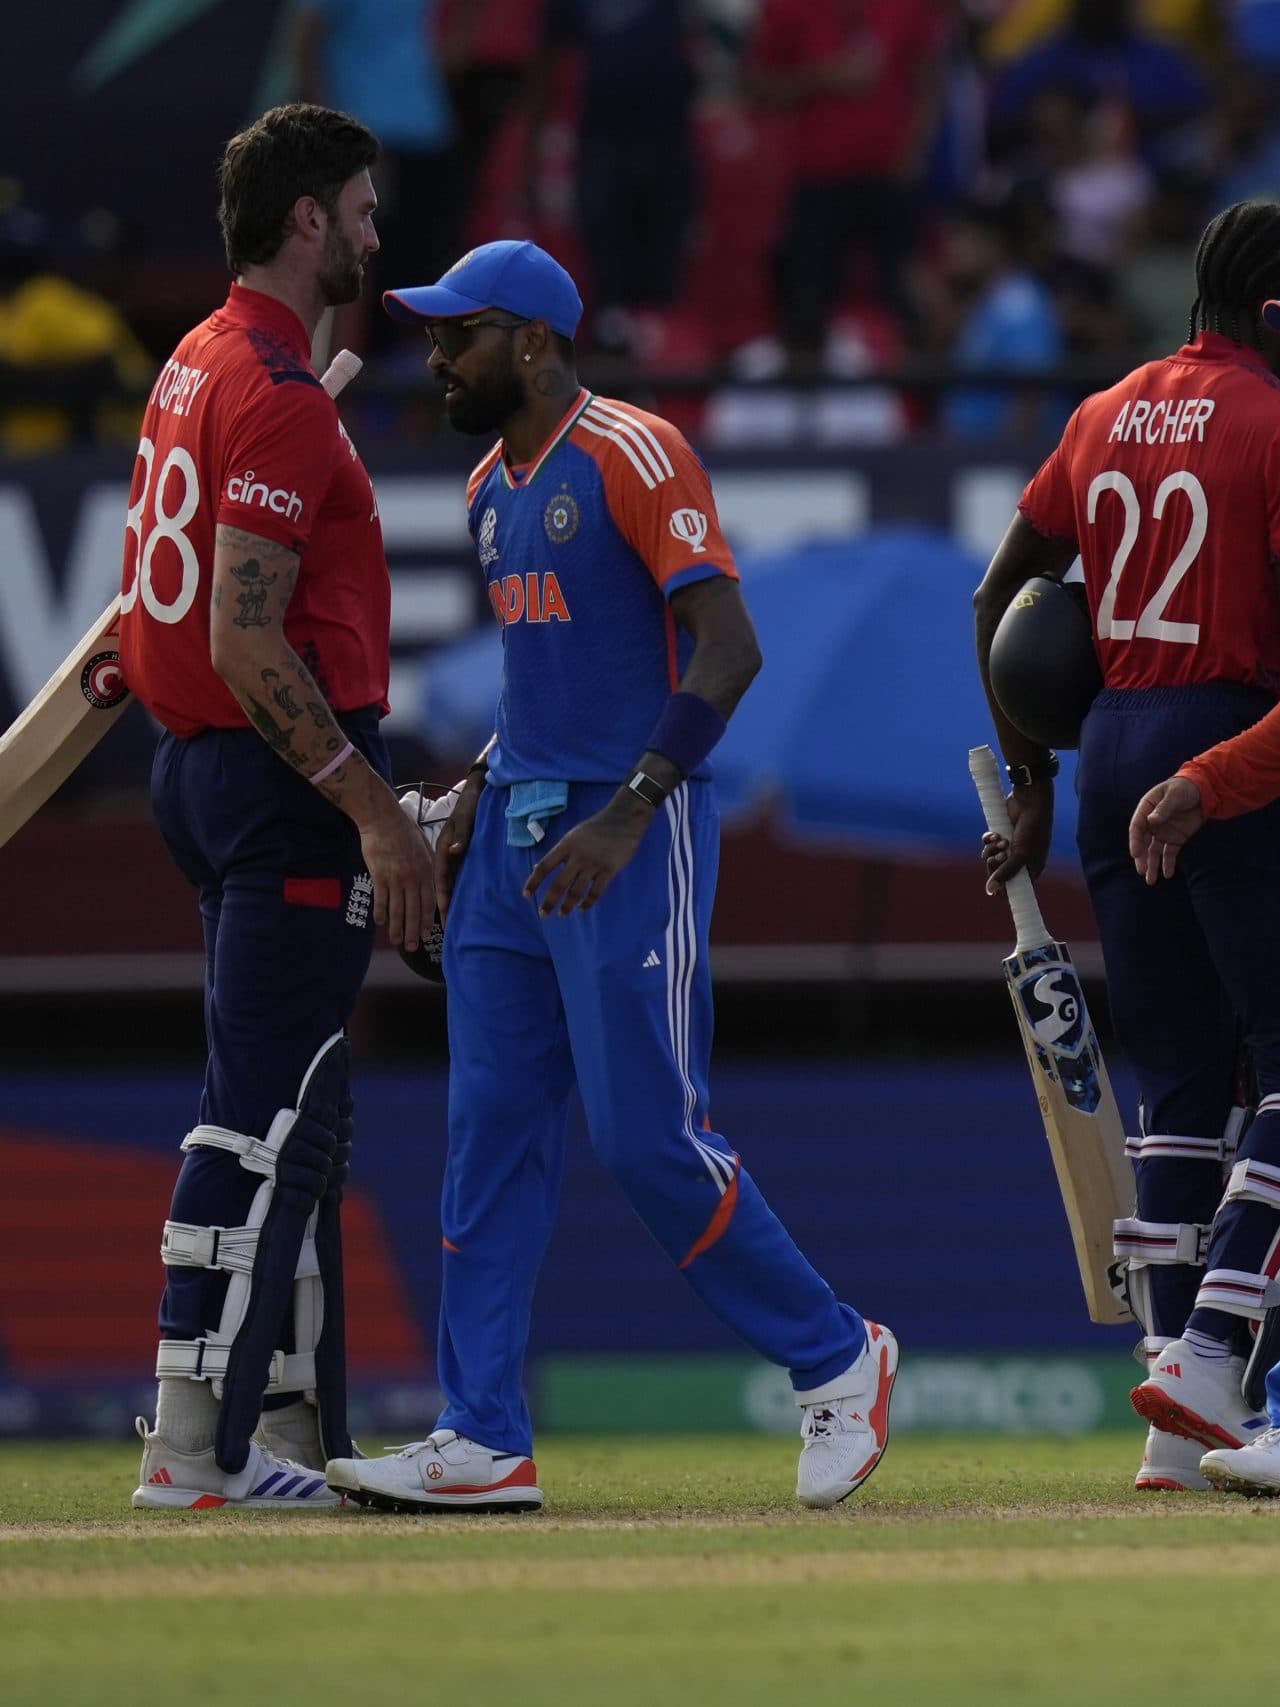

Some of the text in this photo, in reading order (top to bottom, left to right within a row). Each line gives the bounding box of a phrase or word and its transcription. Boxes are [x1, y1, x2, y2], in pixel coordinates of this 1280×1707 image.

[1107, 398, 1216, 445] ARCHER
[227, 470, 304, 523] cinch
[1087, 470, 1209, 645] 22
[488, 571, 572, 631] NDIA
